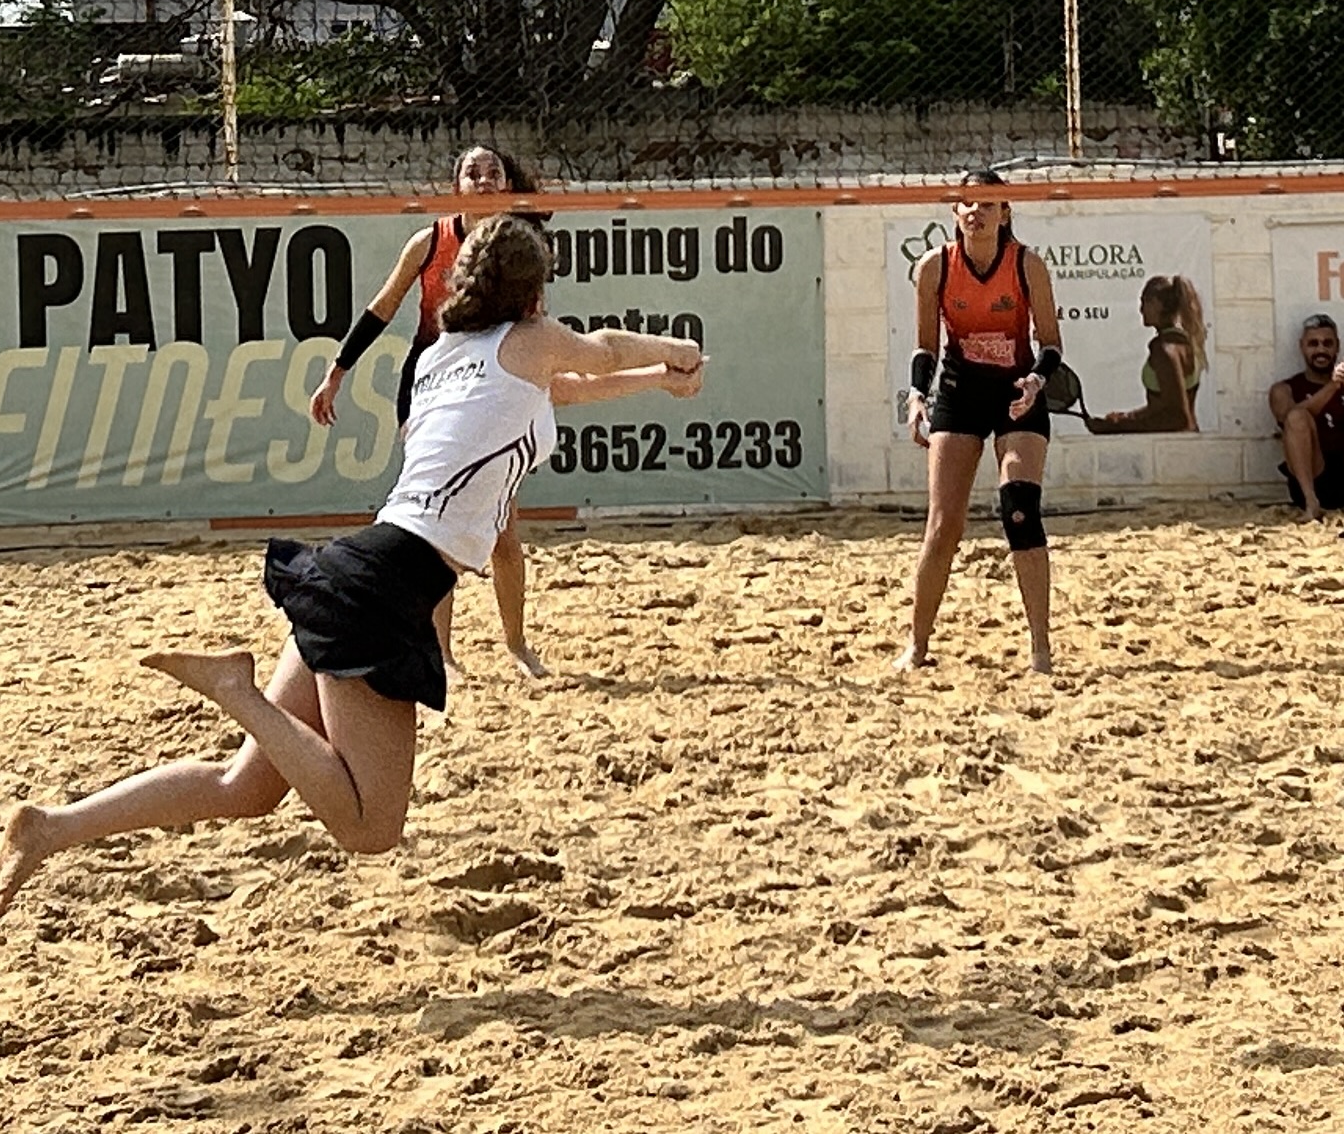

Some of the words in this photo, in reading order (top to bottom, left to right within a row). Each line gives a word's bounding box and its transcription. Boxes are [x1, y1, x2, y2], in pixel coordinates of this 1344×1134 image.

[545, 219, 699, 282] pping
[715, 216, 784, 273] do
[1033, 244, 1144, 266] AFLORA
[17, 224, 352, 352] PATYO
[1068, 308, 1080, 319] O
[1084, 307, 1109, 319] SEU
[550, 420, 803, 474] 3652-3233
